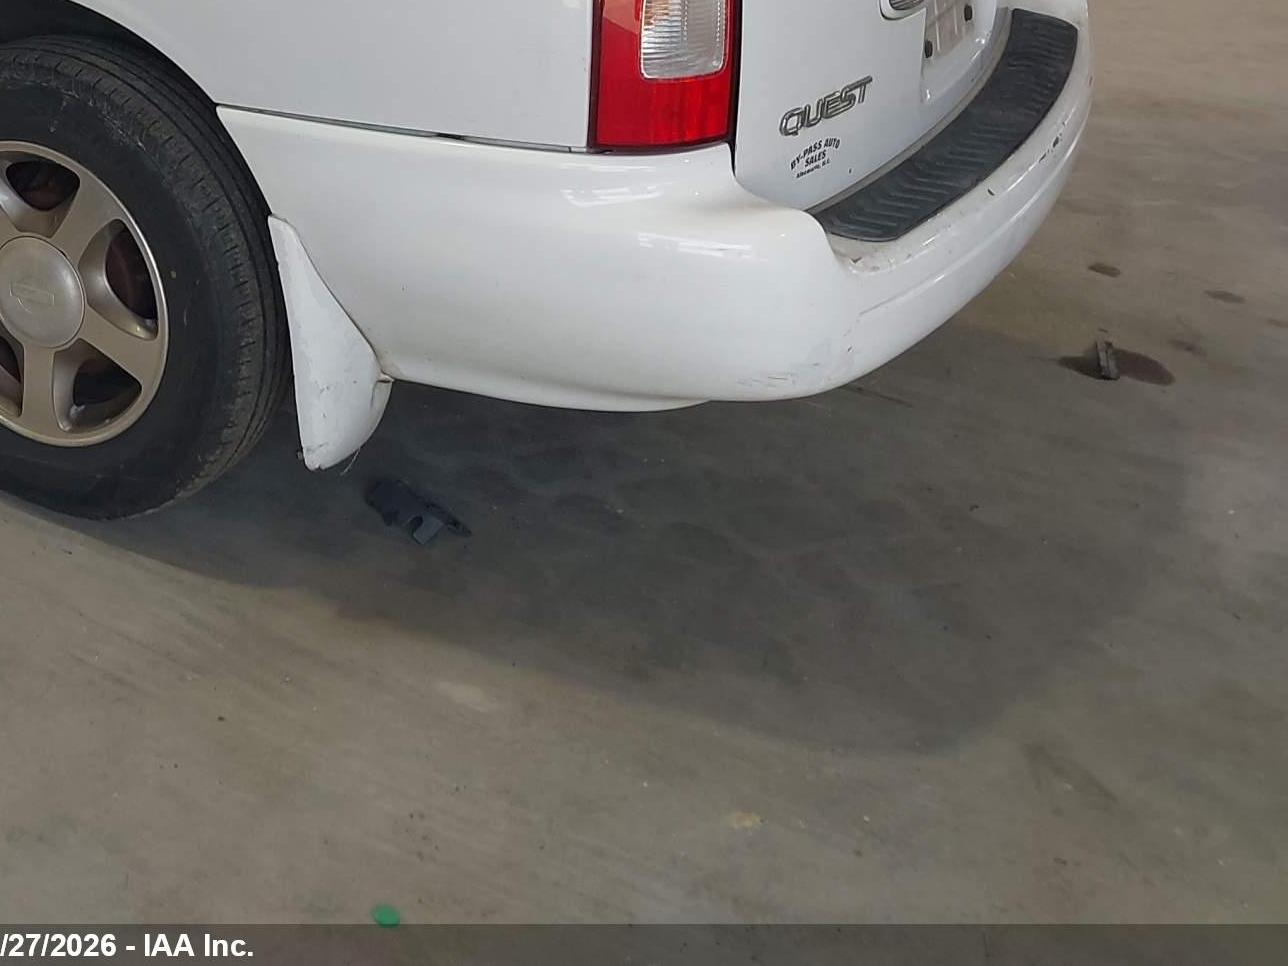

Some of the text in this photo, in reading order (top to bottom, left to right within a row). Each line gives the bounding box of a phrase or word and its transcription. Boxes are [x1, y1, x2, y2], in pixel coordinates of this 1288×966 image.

[779, 75, 873, 136] QUEST
[790, 140, 822, 170] BY-PASS
[823, 137, 840, 149] AUTO
[804, 149, 827, 167] SALES
